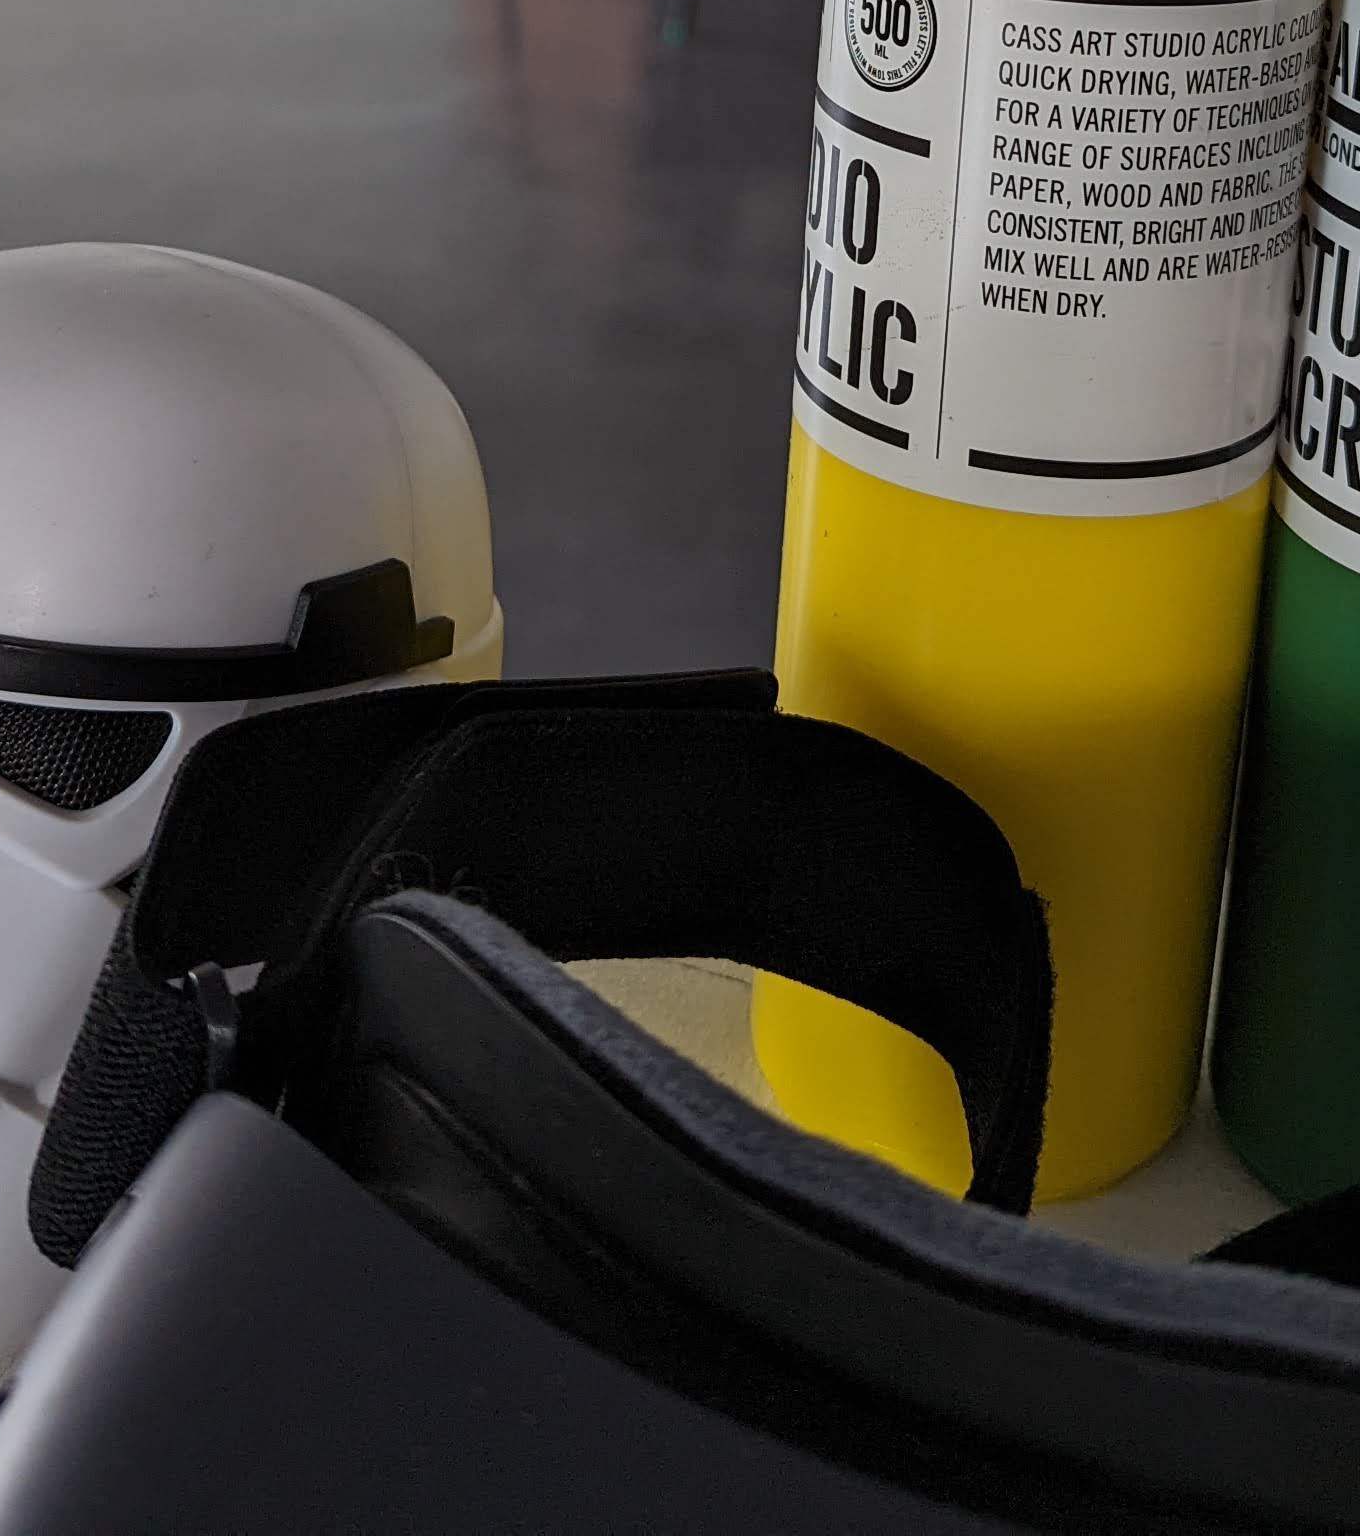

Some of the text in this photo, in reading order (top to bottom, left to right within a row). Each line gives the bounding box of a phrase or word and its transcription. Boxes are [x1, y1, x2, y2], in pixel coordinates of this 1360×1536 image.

[874, 42, 888, 60] ML
[1001, 22, 1062, 54] CASS
[1070, 27, 1114, 57] ART
[1123, 25, 1206, 58] STUDIO
[1212, 19, 1285, 56] ACRYLIC
[998, 60, 1073, 94] QUICK
[1080, 62, 1176, 99] DRYING,
[1185, 52, 1301, 96] WATER-BASED
[995, 97, 1039, 129] FOR
[1046, 103, 1063, 130] A
[1072, 103, 1165, 134] VARIETY
[1173, 102, 1200, 133] OF
[1205, 88, 1300, 132] TECHNIQUES
[993, 135, 1072, 169] RANGE
[1081, 143, 1111, 170] OF
[1119, 141, 1231, 171] SURFACES
[1237, 119, 1304, 165] INCLUDING
[809, 130, 880, 264] DIO
[989, 171, 1072, 209] PAPER,
[1081, 182, 1150, 208] WOOD
[1159, 179, 1204, 208] AND
[1210, 169, 1273, 200] FABRIC.
[1278, 159, 1298, 188] THE
[986, 196, 1296, 249] CONSISTENT, BRIGHT AND INTENSE
[984, 245, 1025, 277] MIX
[1035, 252, 1095, 282] WELL
[1103, 253, 1149, 282] AND
[1157, 248, 1198, 280] ARE
[981, 282, 1107, 319] WHEN DRY.
[802, 248, 917, 405] YLIC
